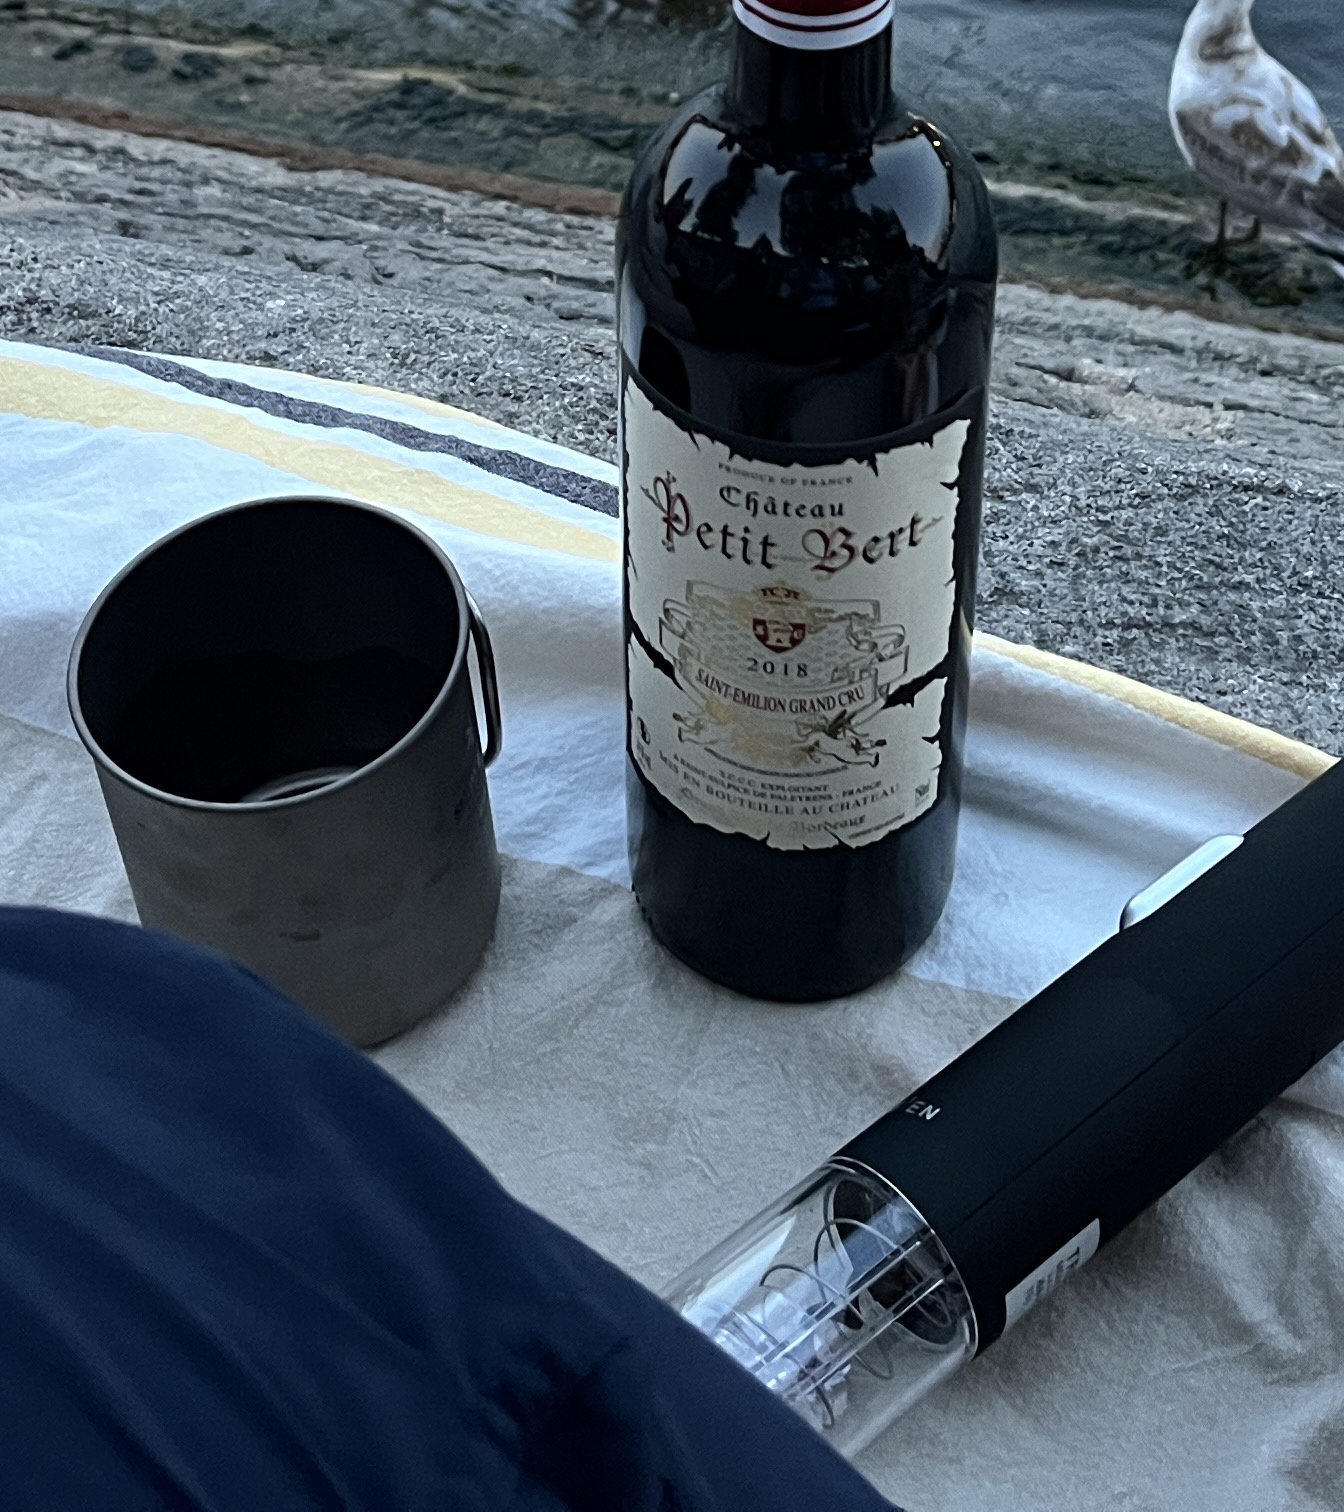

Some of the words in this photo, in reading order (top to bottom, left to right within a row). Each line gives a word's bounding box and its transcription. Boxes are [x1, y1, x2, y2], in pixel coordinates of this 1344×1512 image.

[719, 486, 845, 518] Château
[646, 471, 778, 570] Petit
[801, 510, 931, 573] Bert
[746, 657, 809, 677] 2018
[694, 667, 787, 713] SAINT-EMILION
[789, 695, 836, 714] GRAND
[838, 684, 866, 705] CRU
[706, 785, 794, 816] BOUTEILLE
[799, 805, 823, 816] AU
